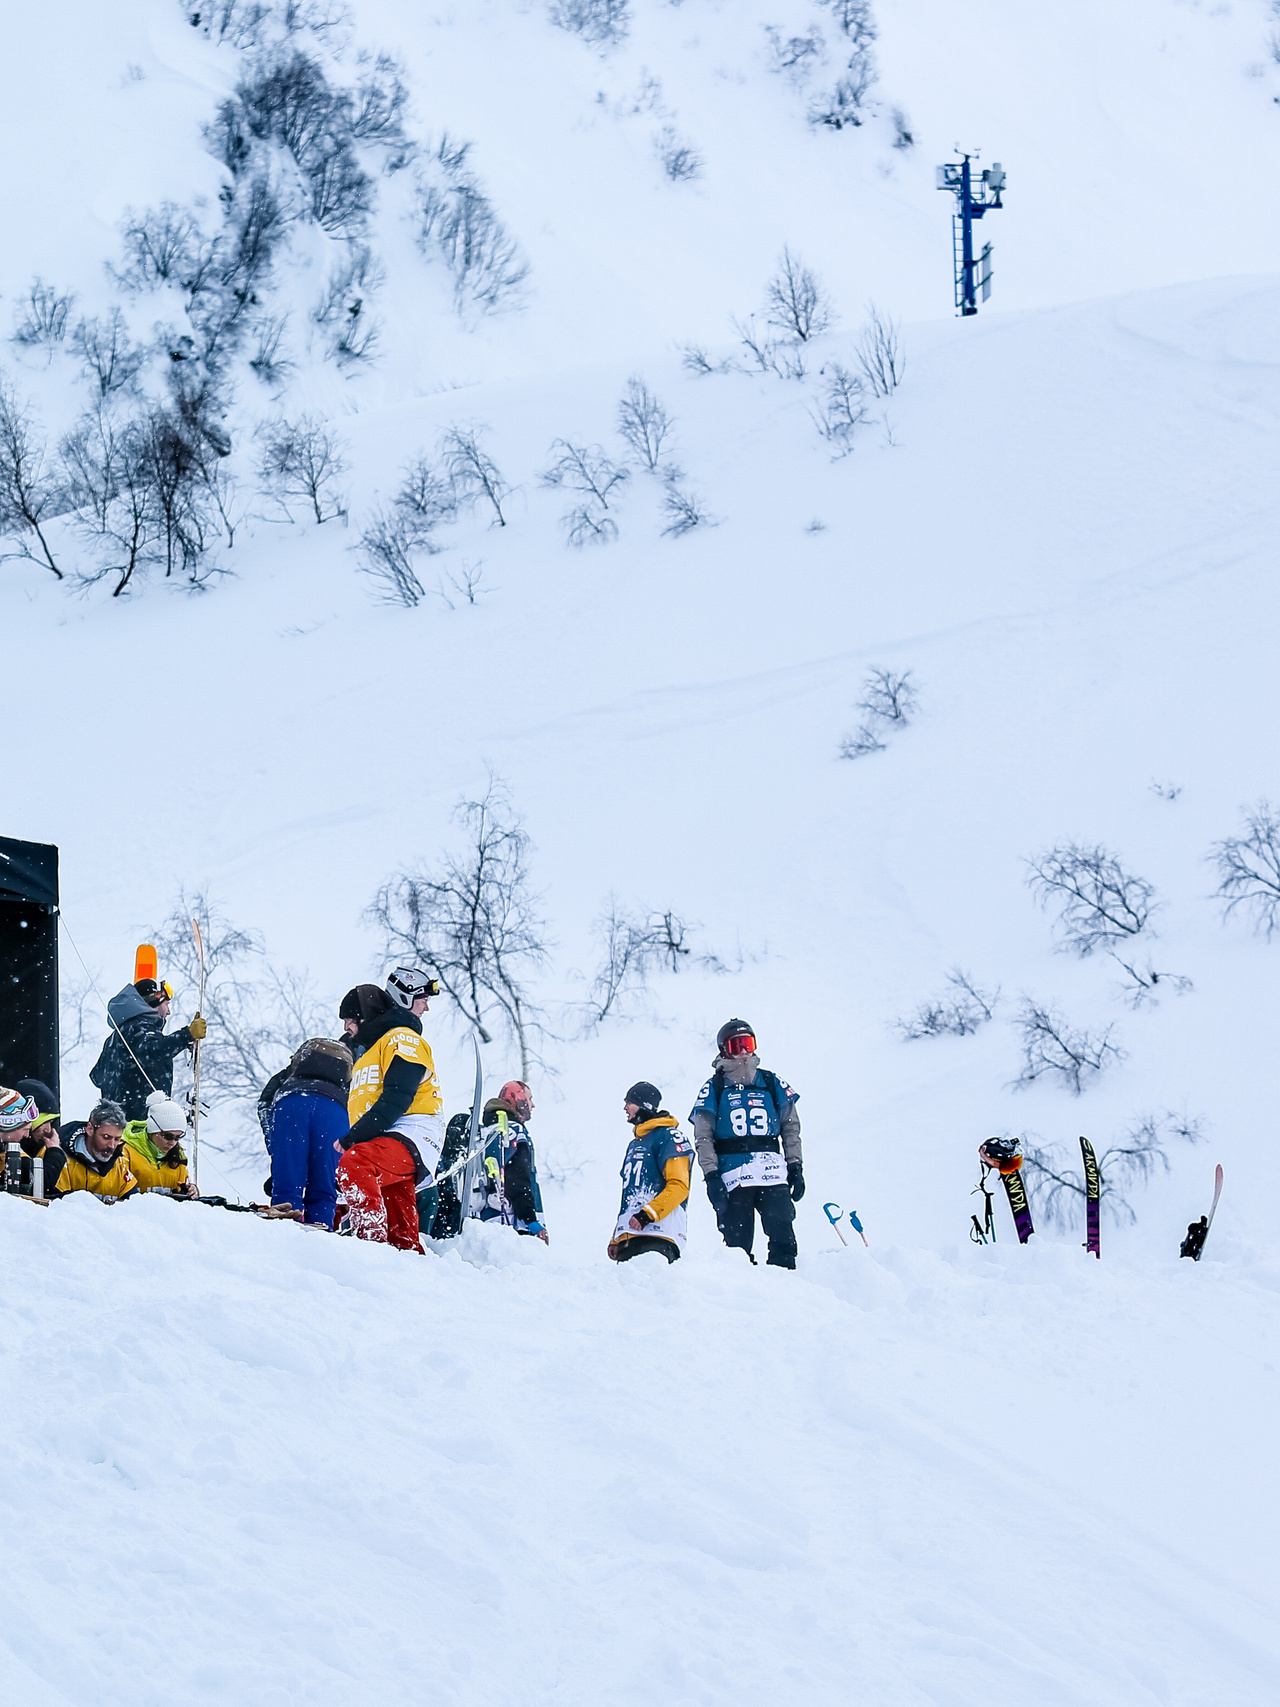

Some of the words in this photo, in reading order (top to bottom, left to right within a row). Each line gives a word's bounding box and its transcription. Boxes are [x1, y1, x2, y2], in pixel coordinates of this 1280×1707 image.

[388, 1032, 420, 1046] JUDGE
[730, 1107, 768, 1137] 83
[623, 1160, 643, 1189] 31
